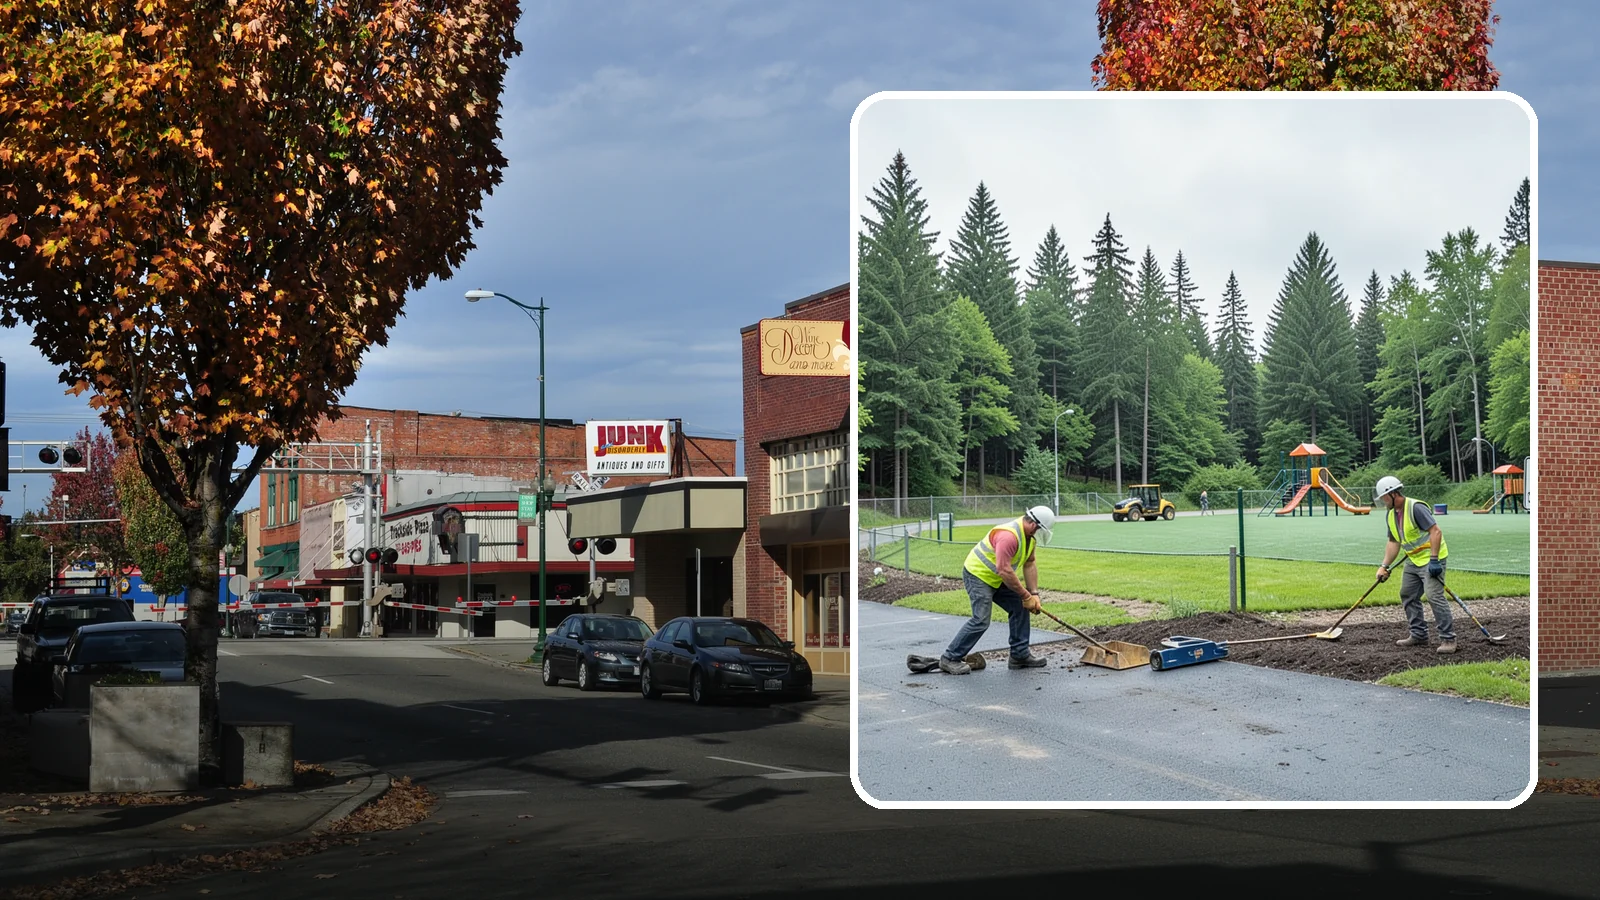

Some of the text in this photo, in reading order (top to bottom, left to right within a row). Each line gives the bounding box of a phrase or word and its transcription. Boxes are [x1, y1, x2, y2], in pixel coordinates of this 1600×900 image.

[595, 425, 666, 457] JUNK
[607, 446, 646, 454] DISORDERLY
[596, 460, 666, 470] ANTIQUES AND GIFTS
[390, 519, 429, 540] Trackside Pizza
